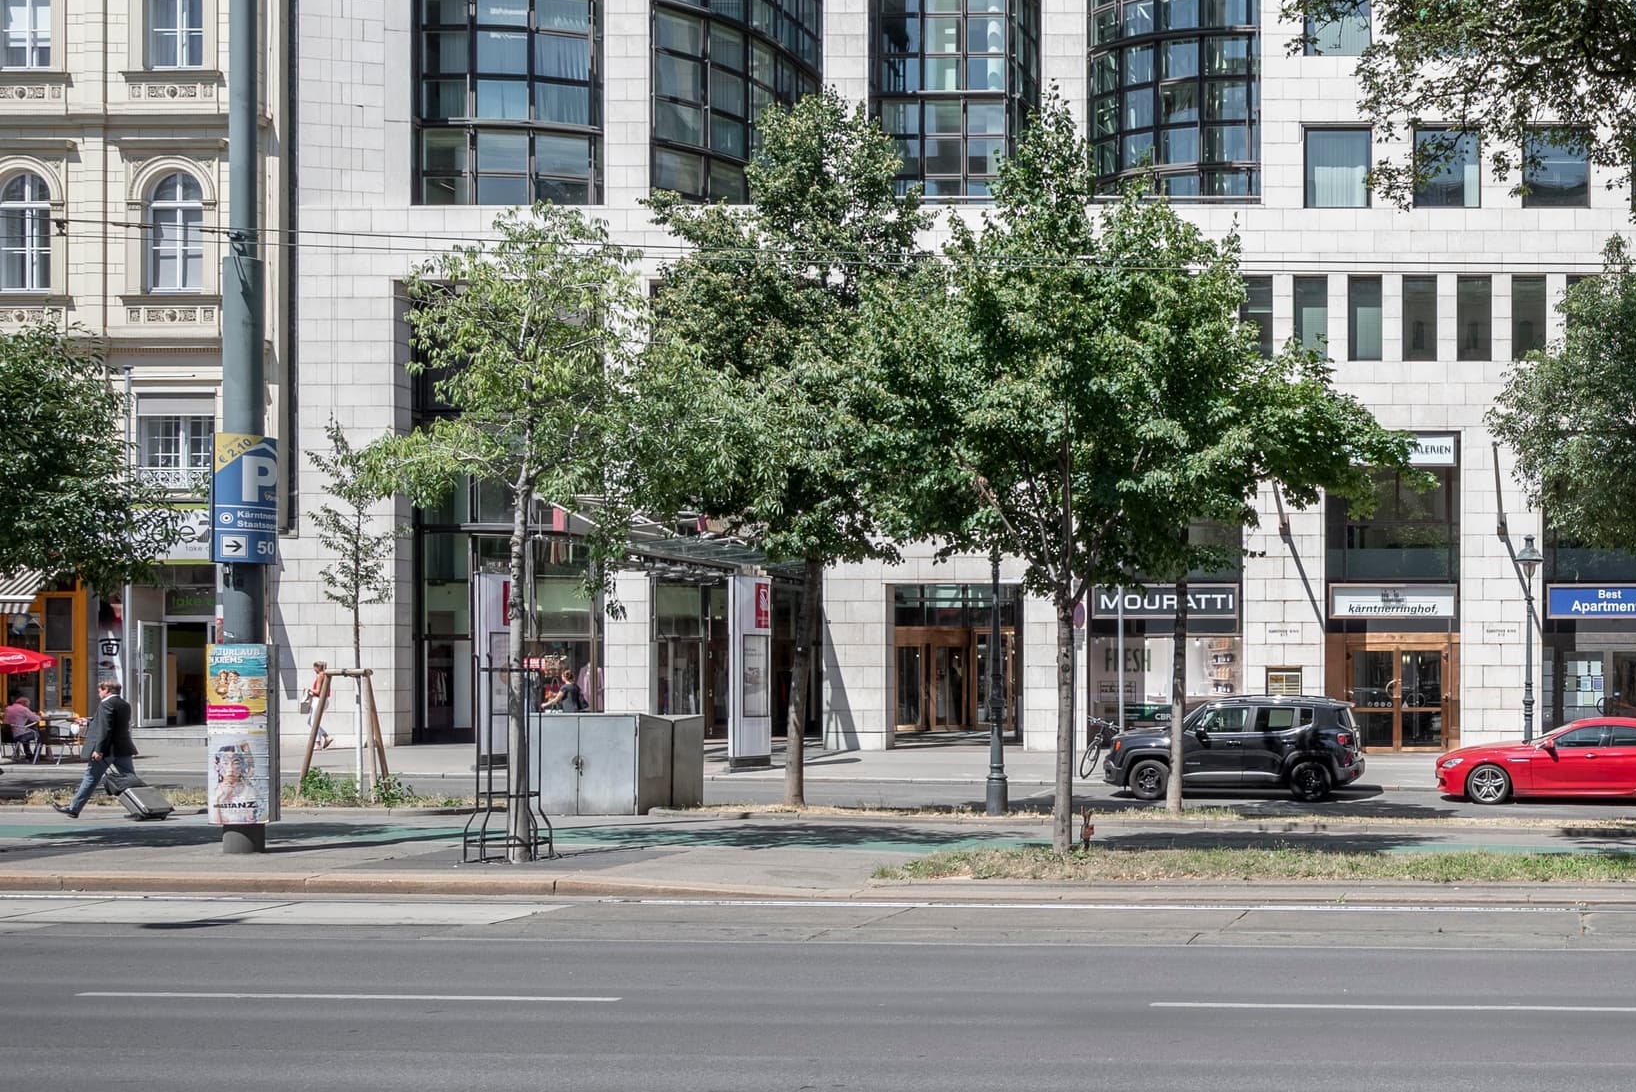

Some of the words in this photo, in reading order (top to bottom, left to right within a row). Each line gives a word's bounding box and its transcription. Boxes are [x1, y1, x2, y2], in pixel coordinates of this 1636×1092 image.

[1410, 445, 1451, 455] ALERIEN
[242, 455, 278, 502] P
[256, 541, 275, 555] 50
[1598, 589, 1622, 599] Best
[1155, 713, 1172, 721] CBR
